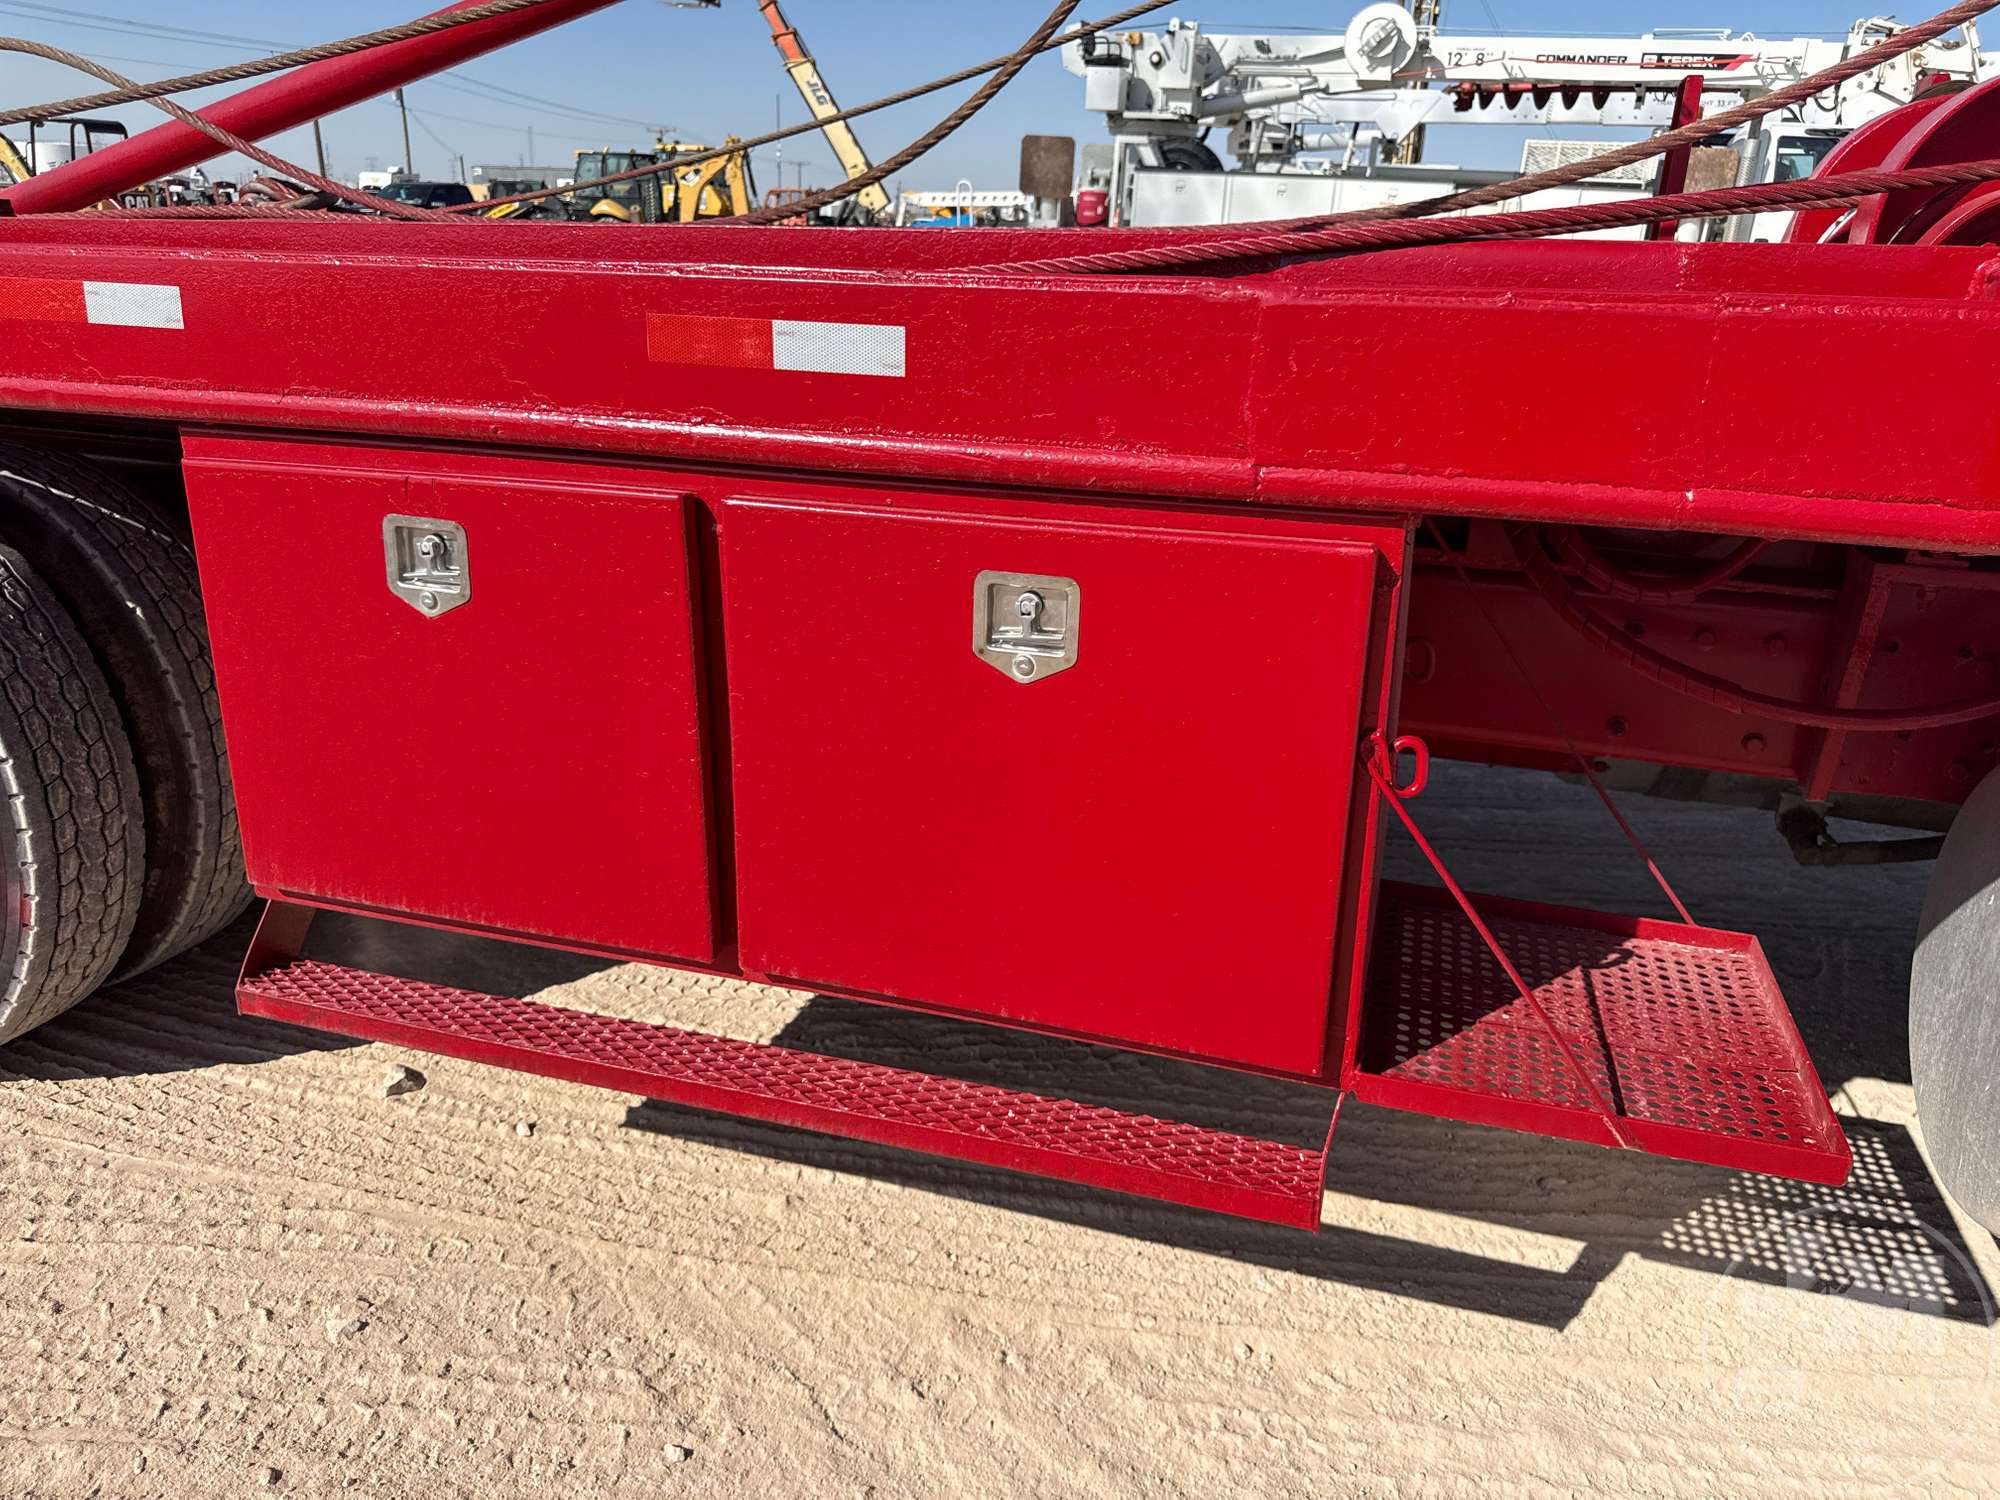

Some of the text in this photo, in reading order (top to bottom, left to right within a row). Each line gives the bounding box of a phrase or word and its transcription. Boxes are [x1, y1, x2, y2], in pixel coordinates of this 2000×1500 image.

[1535, 54, 1628, 64] COMMANDER
[1661, 55, 1715, 68] TEREX
[806, 80, 829, 106] JLG
[124, 195, 150, 209] CAT
